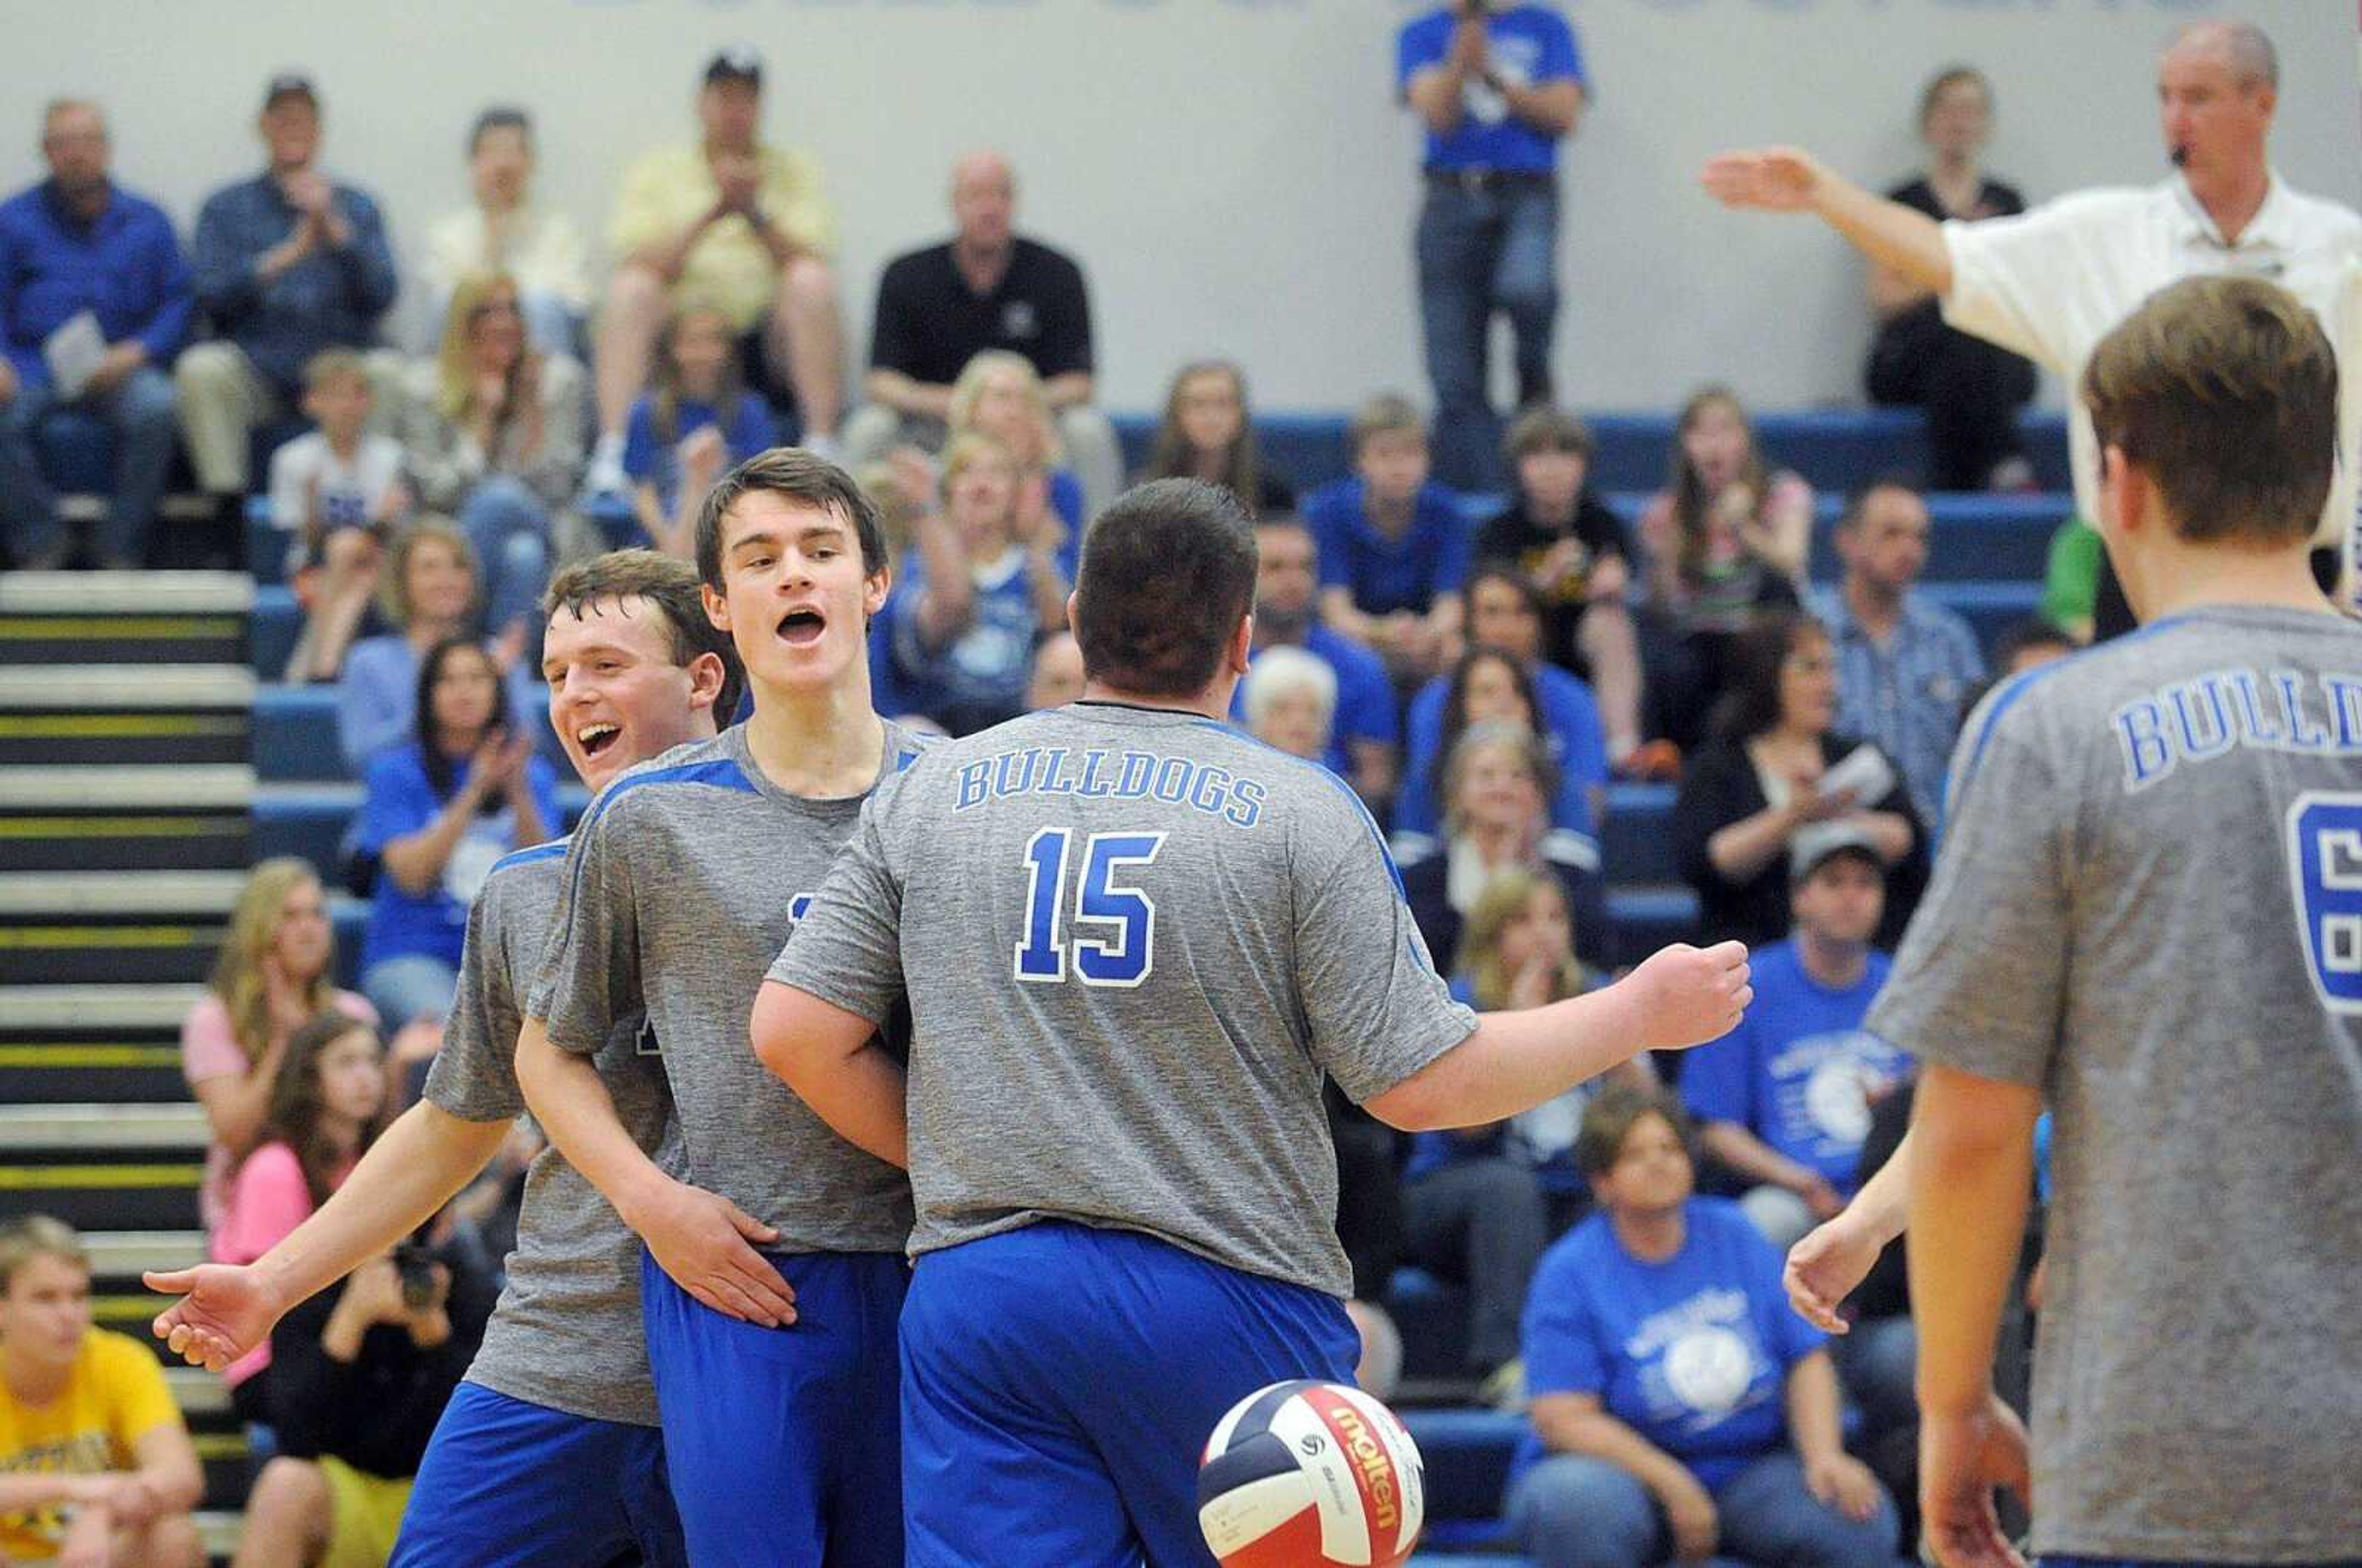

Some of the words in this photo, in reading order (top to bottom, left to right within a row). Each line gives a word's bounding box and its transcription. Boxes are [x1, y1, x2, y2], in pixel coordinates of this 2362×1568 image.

[953, 747, 1267, 829] BULLDOGS
[1014, 826, 1169, 987] 15
[1330, 1407, 1396, 1529] molten
